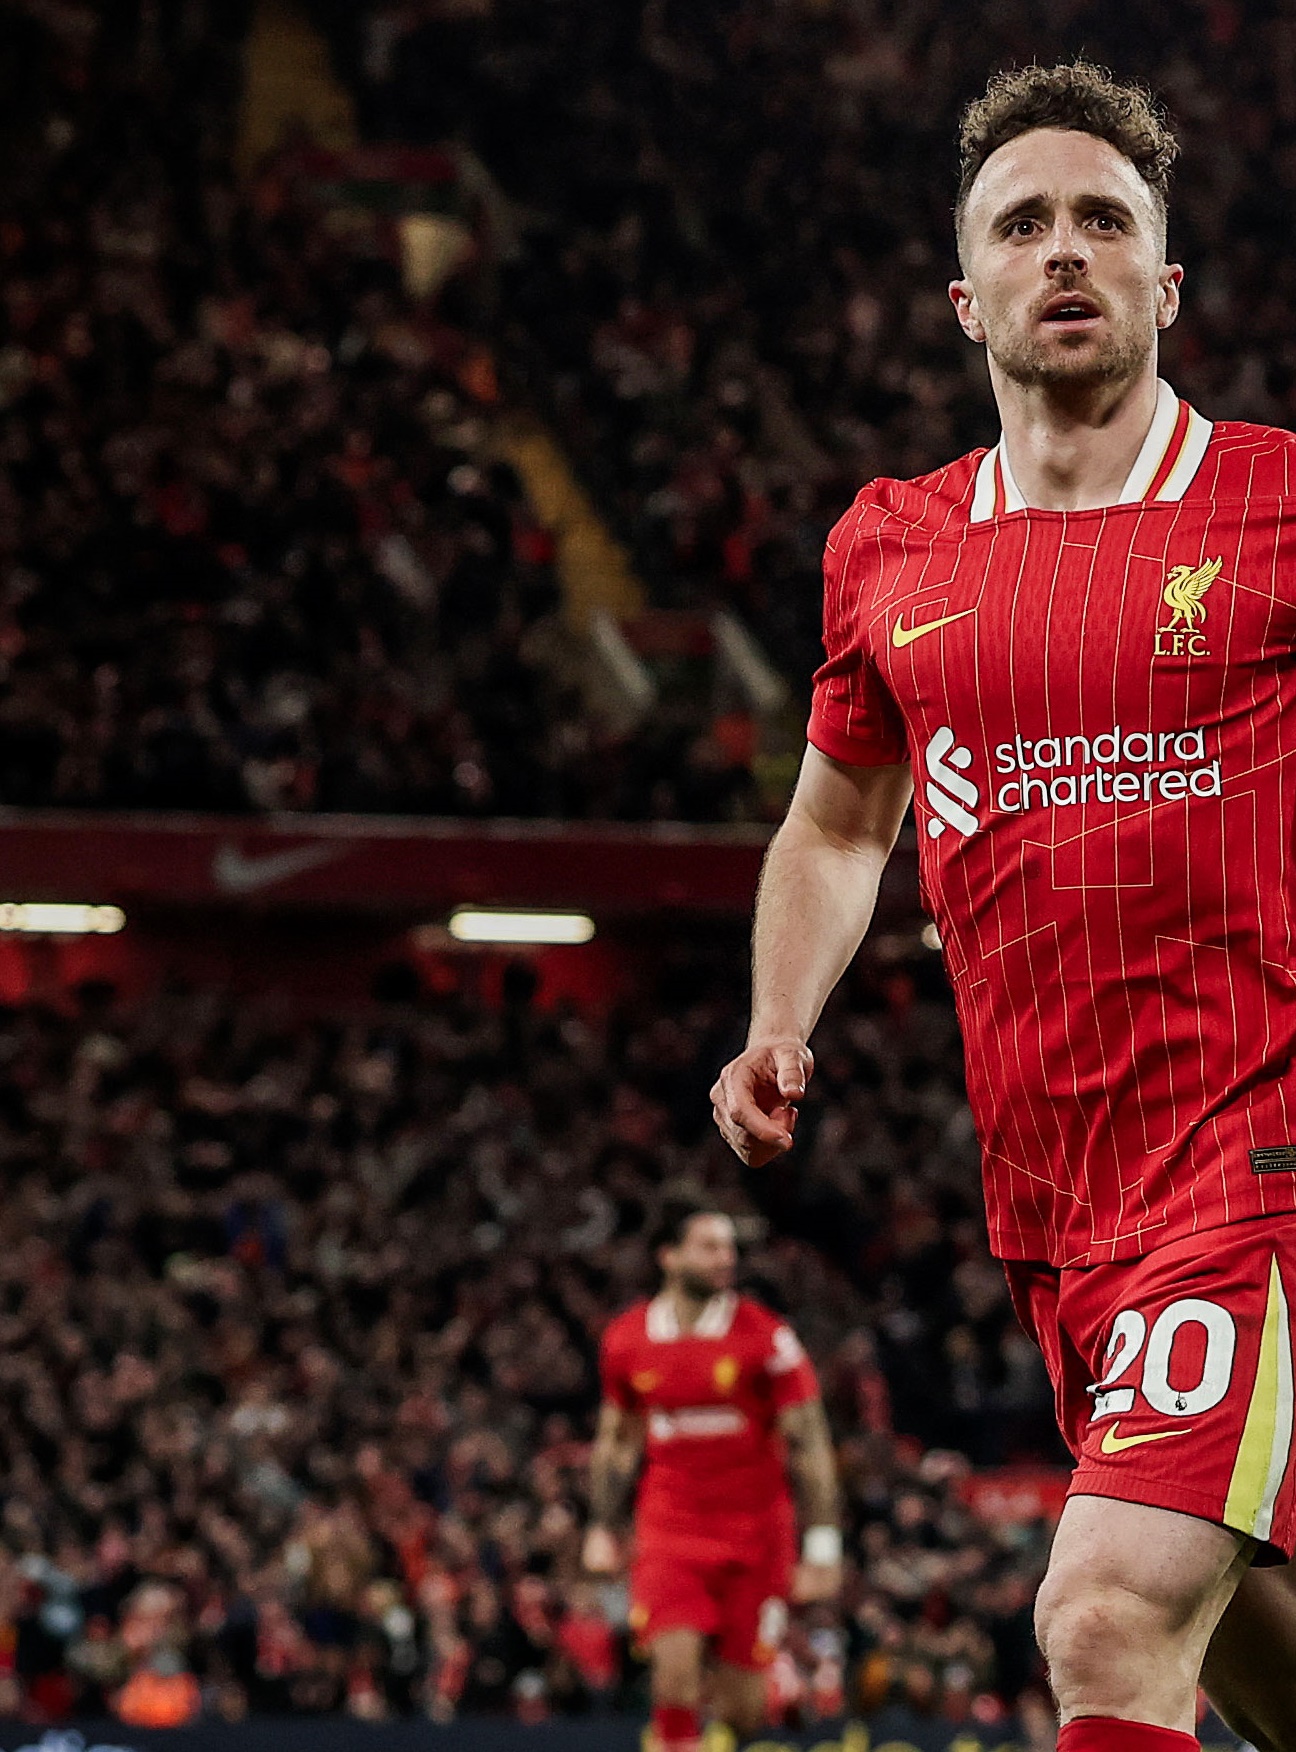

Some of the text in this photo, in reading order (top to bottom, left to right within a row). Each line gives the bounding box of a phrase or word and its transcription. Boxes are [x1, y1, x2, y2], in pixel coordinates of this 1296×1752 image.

[1154, 634, 1211, 656] L.F.C.
[996, 725, 1205, 774] standard
[998, 760, 1222, 812] chartered
[1086, 1298, 1238, 1422] 20
